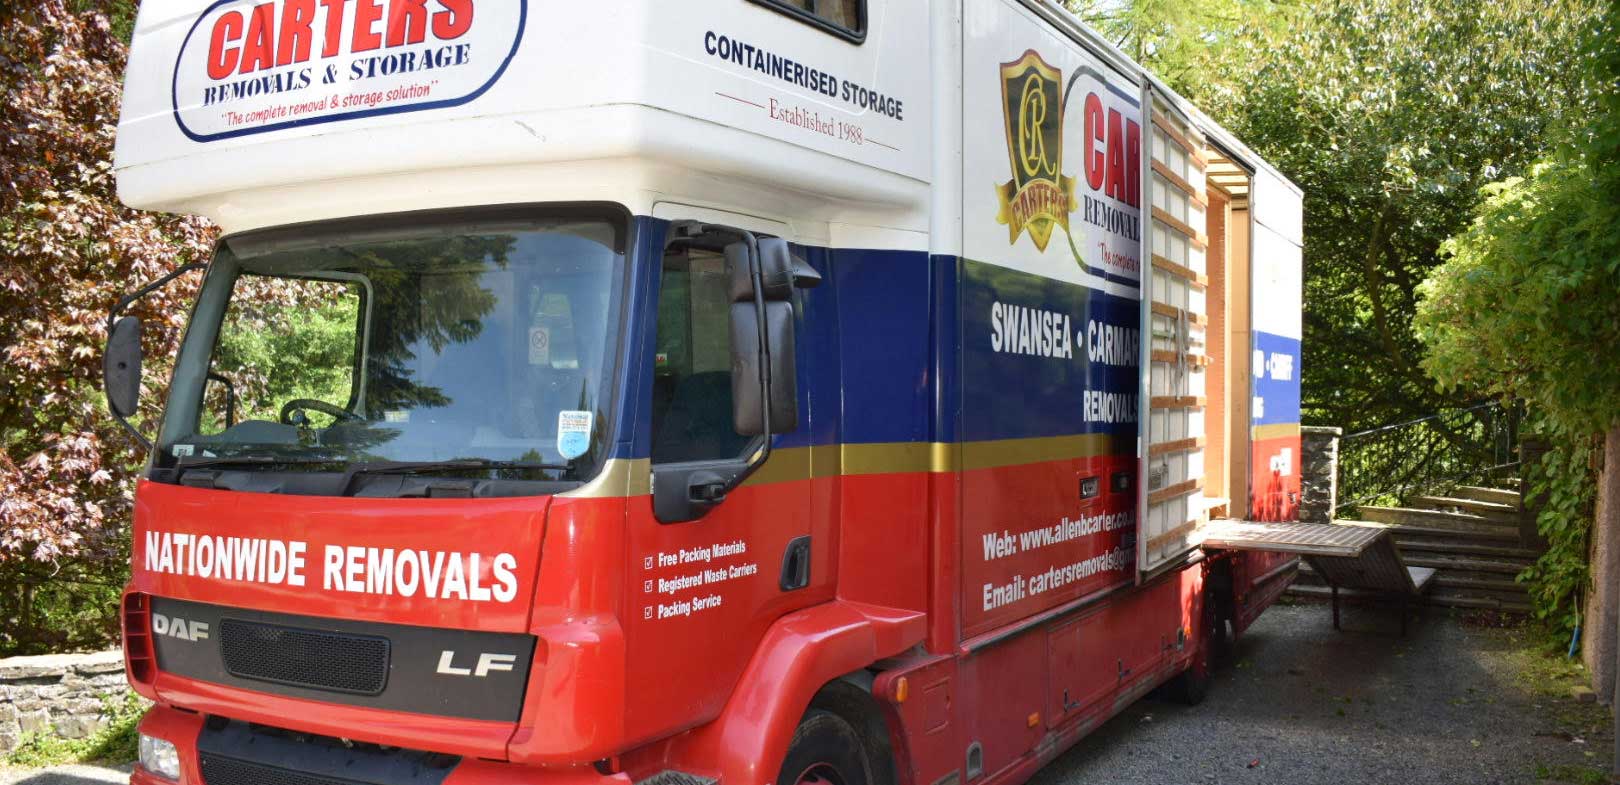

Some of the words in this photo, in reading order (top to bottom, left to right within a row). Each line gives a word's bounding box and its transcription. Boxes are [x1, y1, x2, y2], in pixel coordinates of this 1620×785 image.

[207, 0, 474, 80] CARTERS
[203, 68, 312, 107] REMOVALS
[322, 63, 338, 85] &
[349, 44, 471, 81] STORAGE
[704, 31, 837, 97] CONTAINERISED
[842, 80, 904, 121] STORAGE
[245, 104, 287, 125] complete
[288, 95, 327, 116] removal
[330, 94, 340, 109] &
[342, 88, 384, 108] storage
[769, 98, 835, 137] Established
[838, 122, 864, 145] 1988
[991, 301, 1072, 359] SWANSEA
[658, 552, 677, 567] Free
[679, 547, 711, 564] Packing
[712, 540, 746, 558] Materials
[983, 529, 1017, 561] Web:
[145, 530, 306, 586] NATIONWIDE
[323, 544, 518, 603] REMOVALS
[658, 571, 702, 595] Registered
[704, 567, 728, 584] Waste
[729, 562, 757, 579] Carriers
[658, 600, 691, 619] Packing
[692, 594, 721, 612] Service
[983, 574, 1026, 612] Email:
[152, 613, 210, 642] DAF
[436, 650, 517, 677] LF
